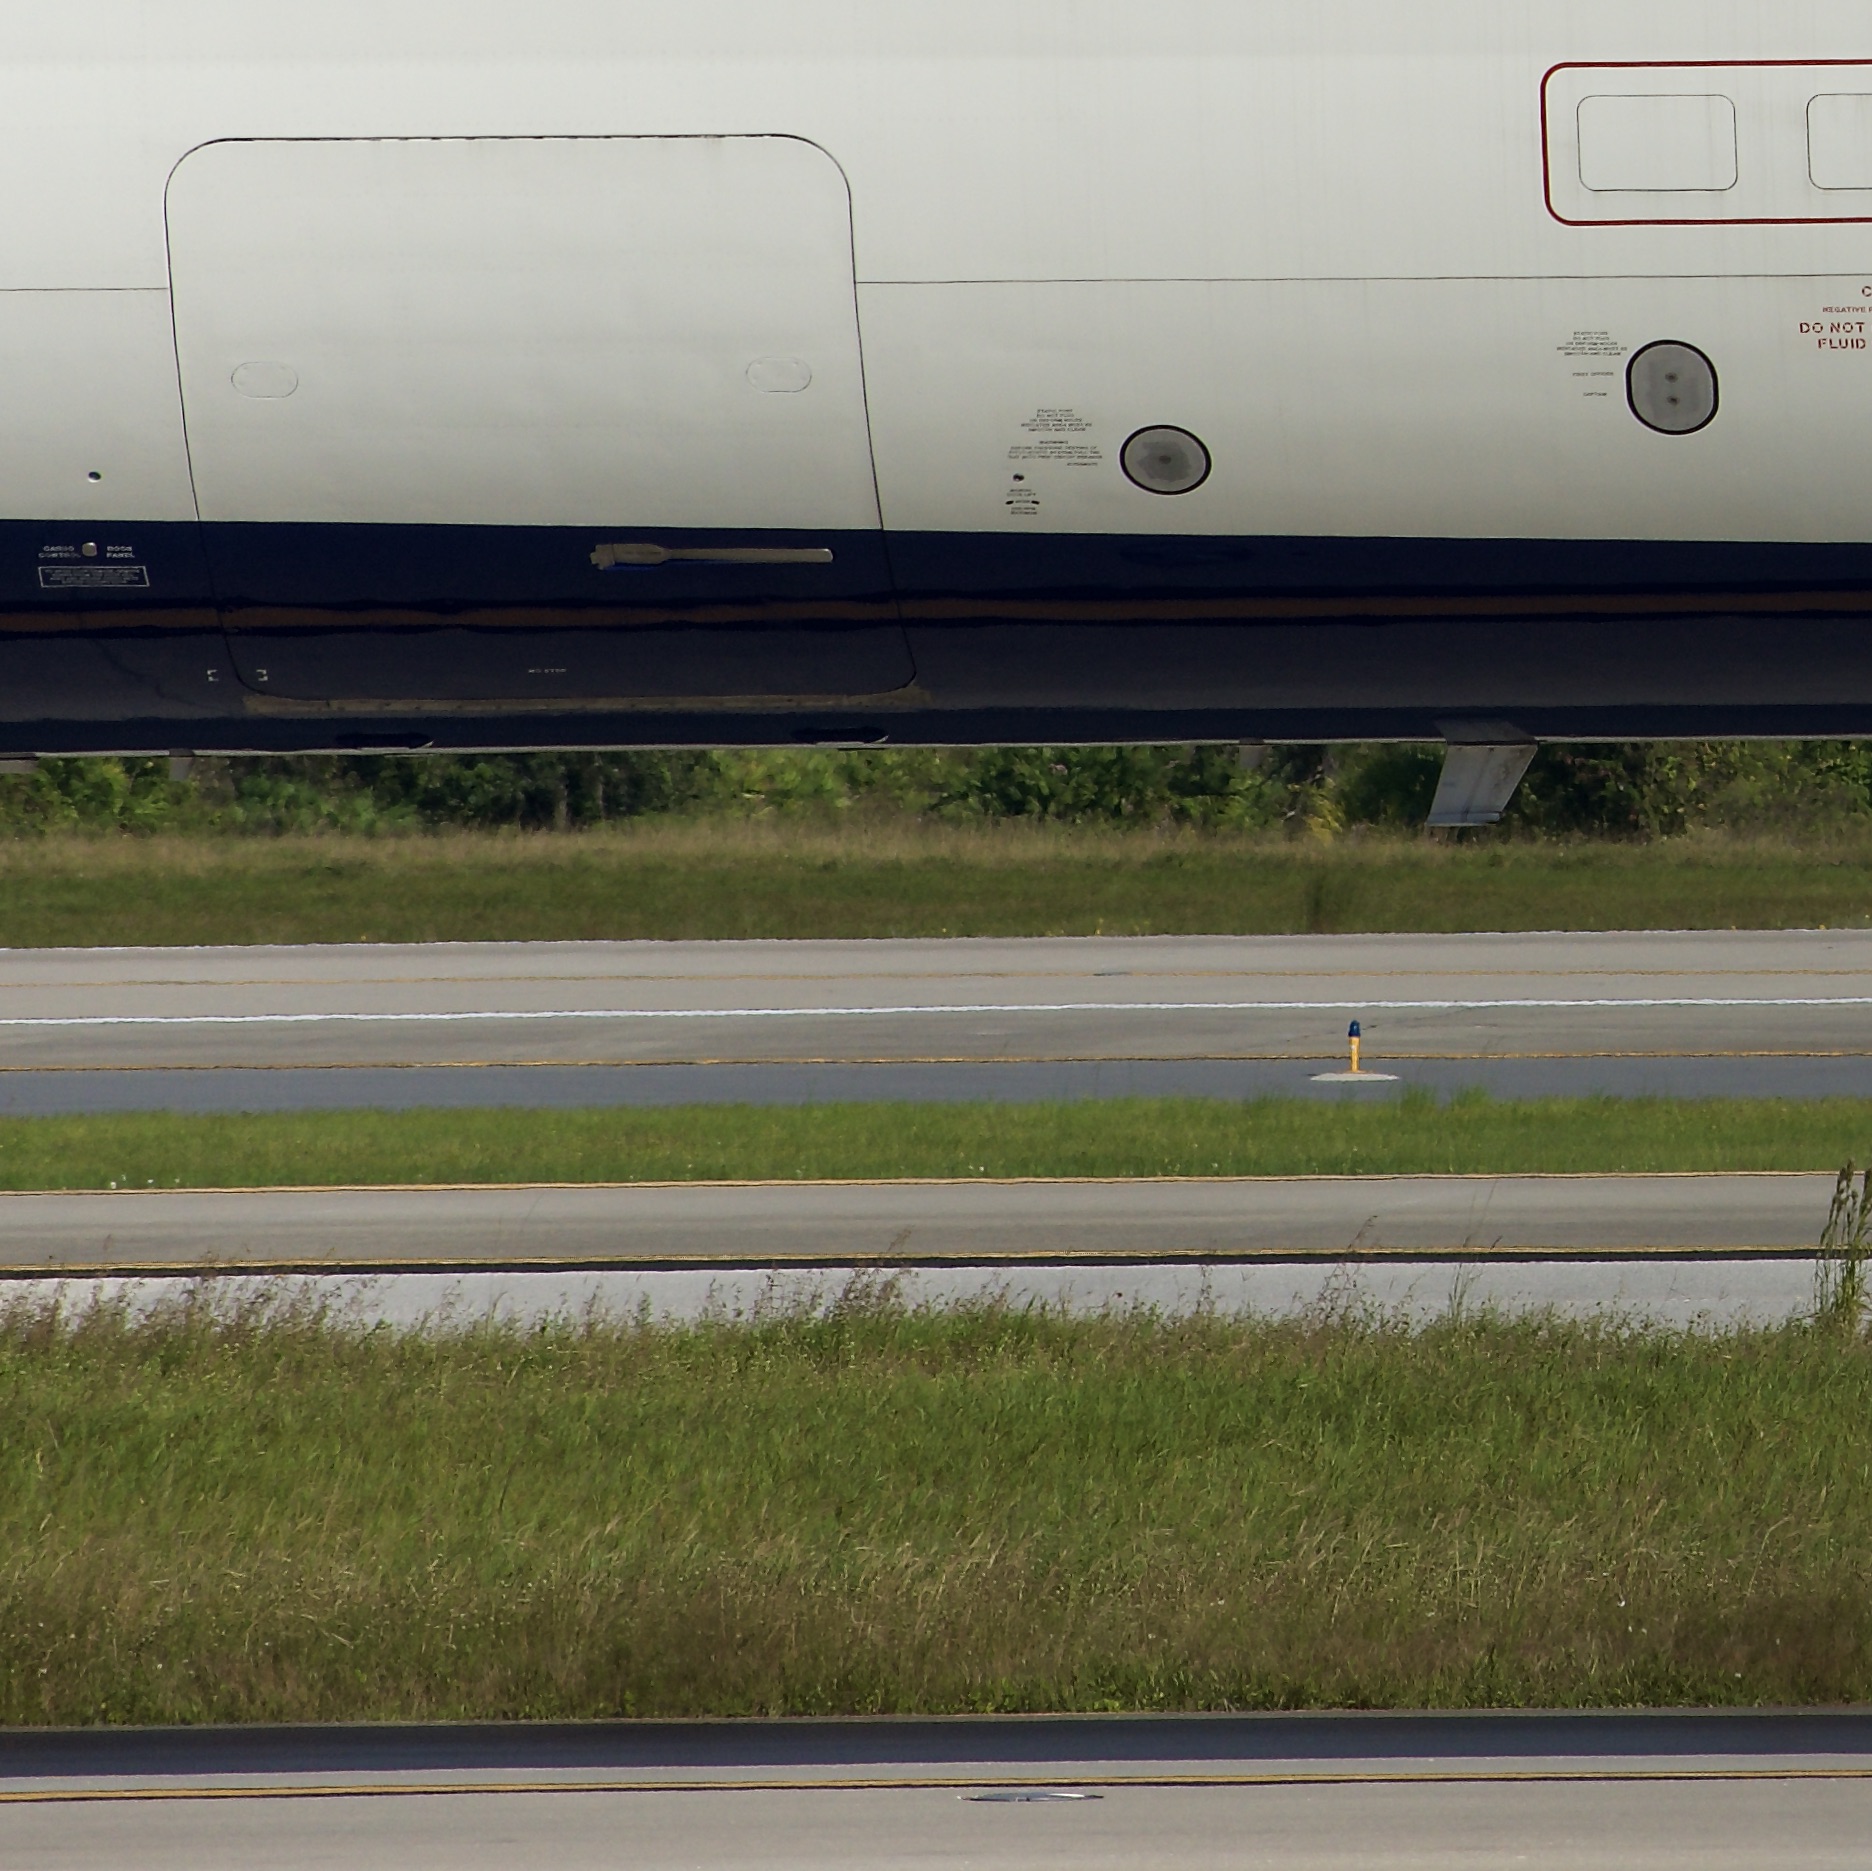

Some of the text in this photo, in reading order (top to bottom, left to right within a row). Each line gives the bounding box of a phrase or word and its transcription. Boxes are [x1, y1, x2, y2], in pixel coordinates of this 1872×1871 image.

[1799, 322, 1824, 333] DO
[1830, 322, 1865, 333] NOT
[1818, 338, 1866, 349] FLUID
